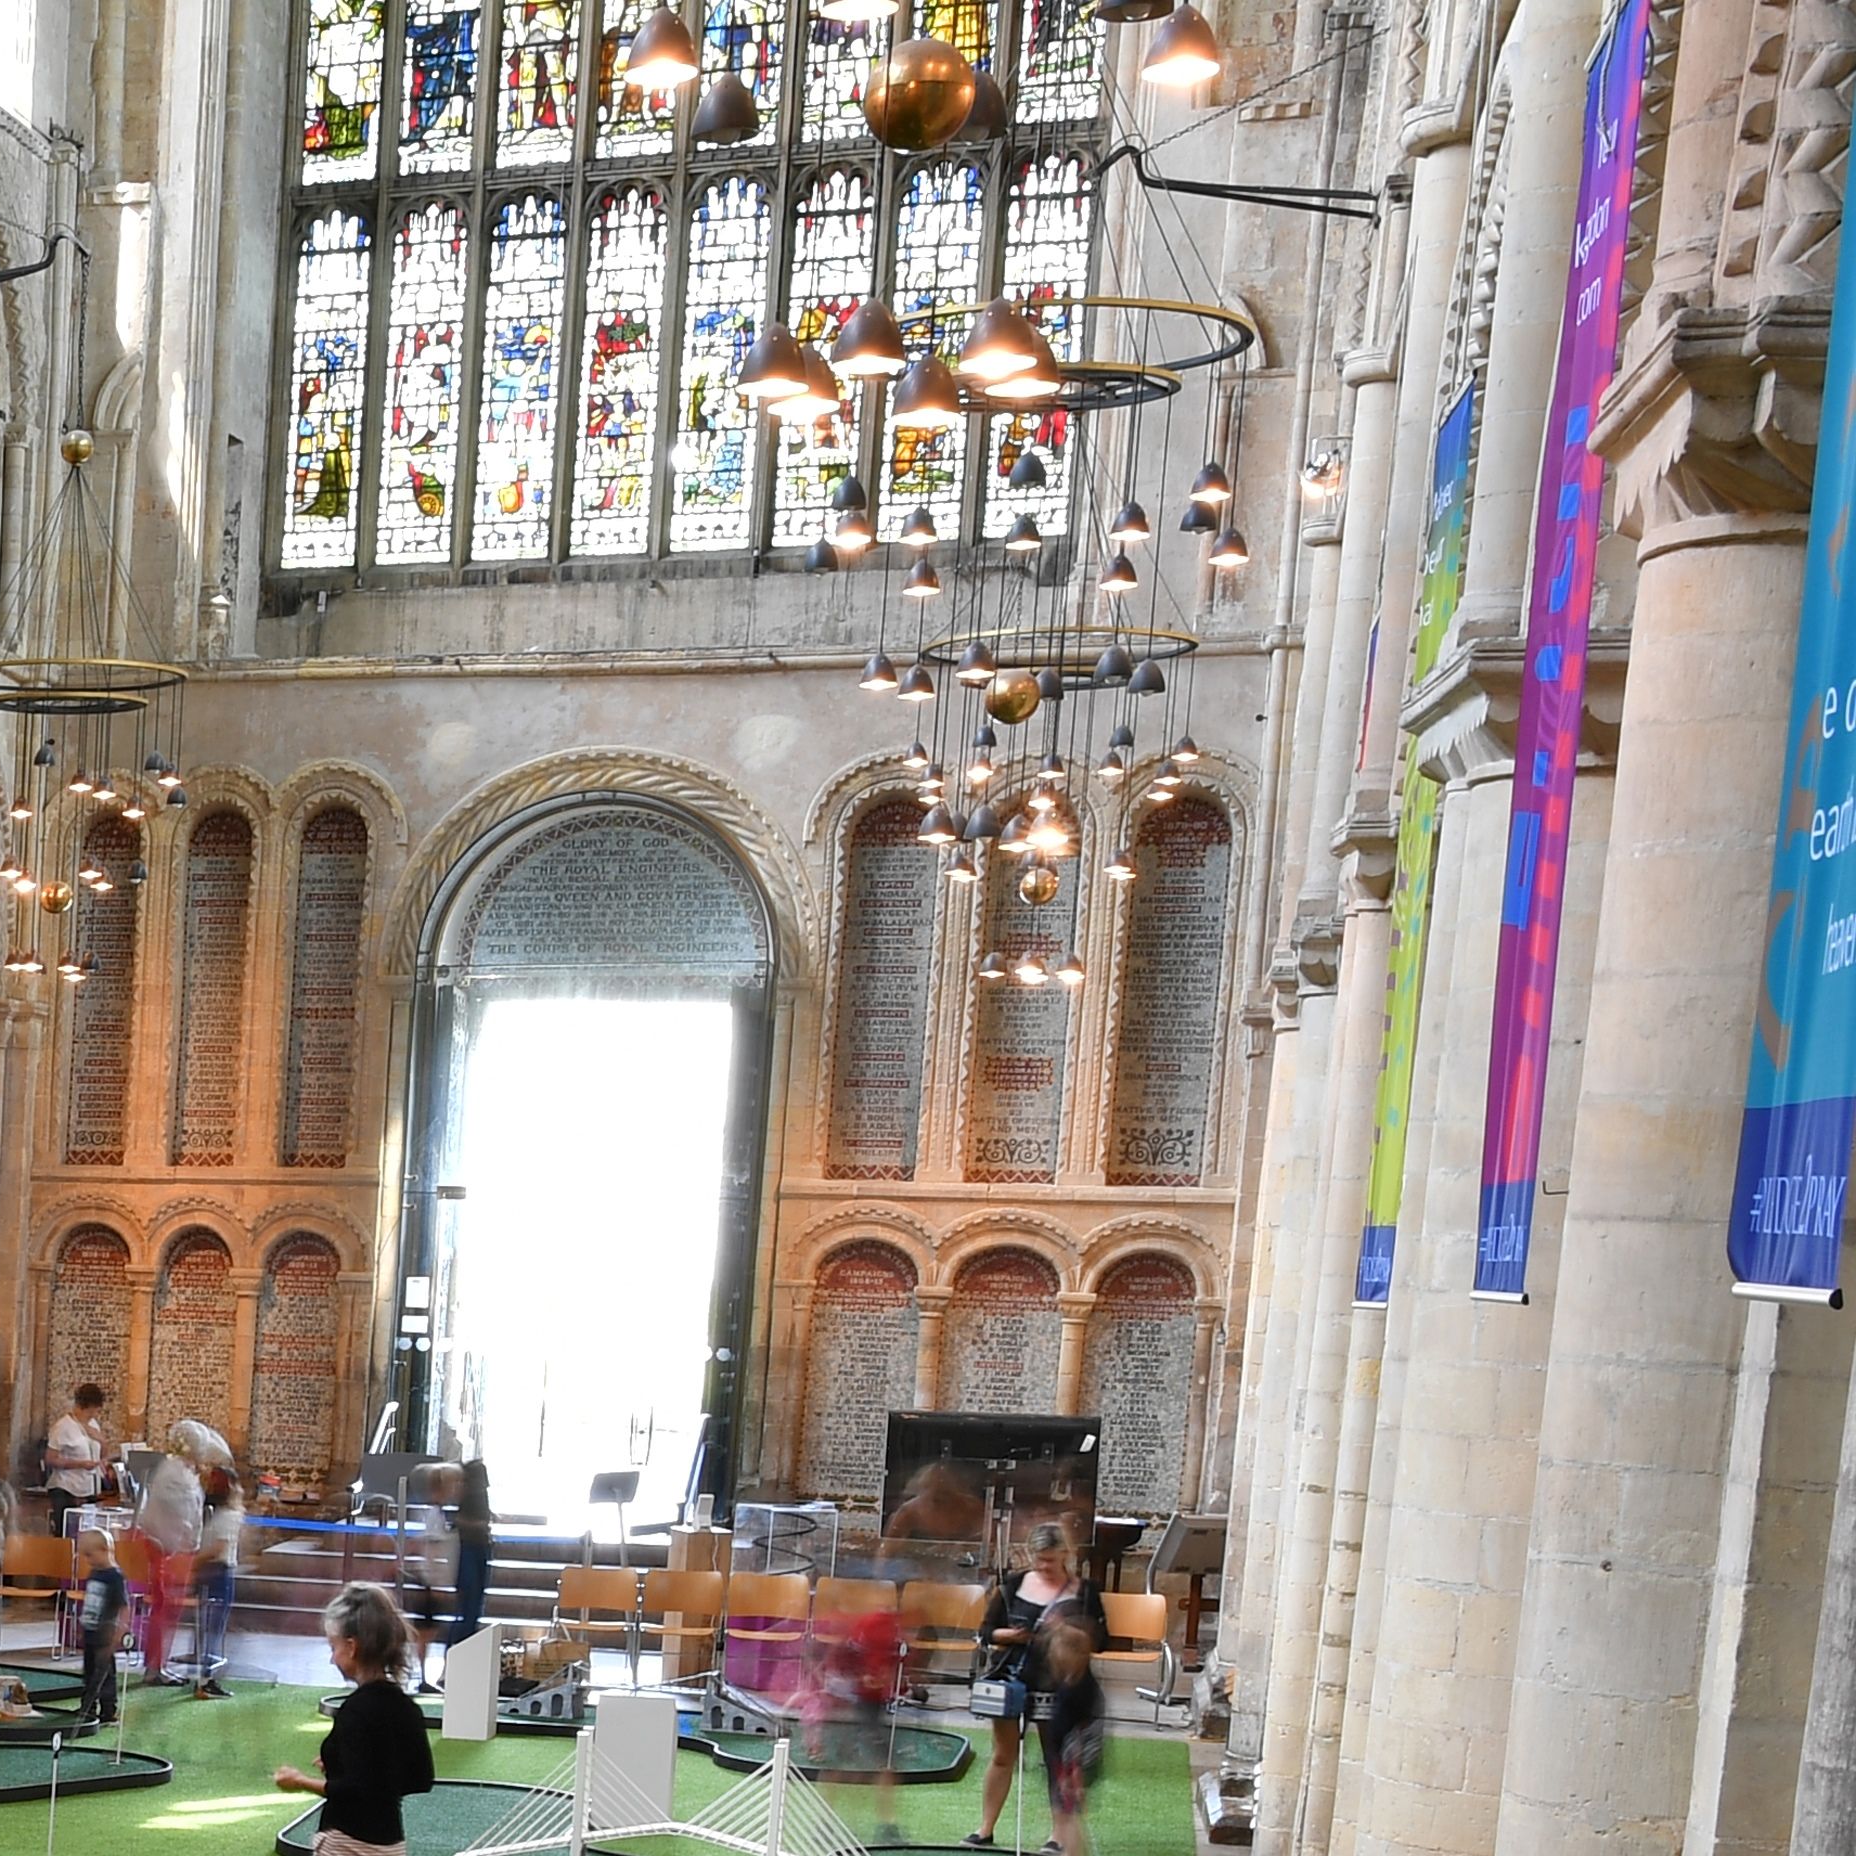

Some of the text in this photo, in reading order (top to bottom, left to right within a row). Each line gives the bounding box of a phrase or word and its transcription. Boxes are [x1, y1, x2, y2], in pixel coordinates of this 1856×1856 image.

[642, 837, 669, 848] GOD
[528, 865, 558, 876] THE
[564, 864, 610, 875] ROYAL
